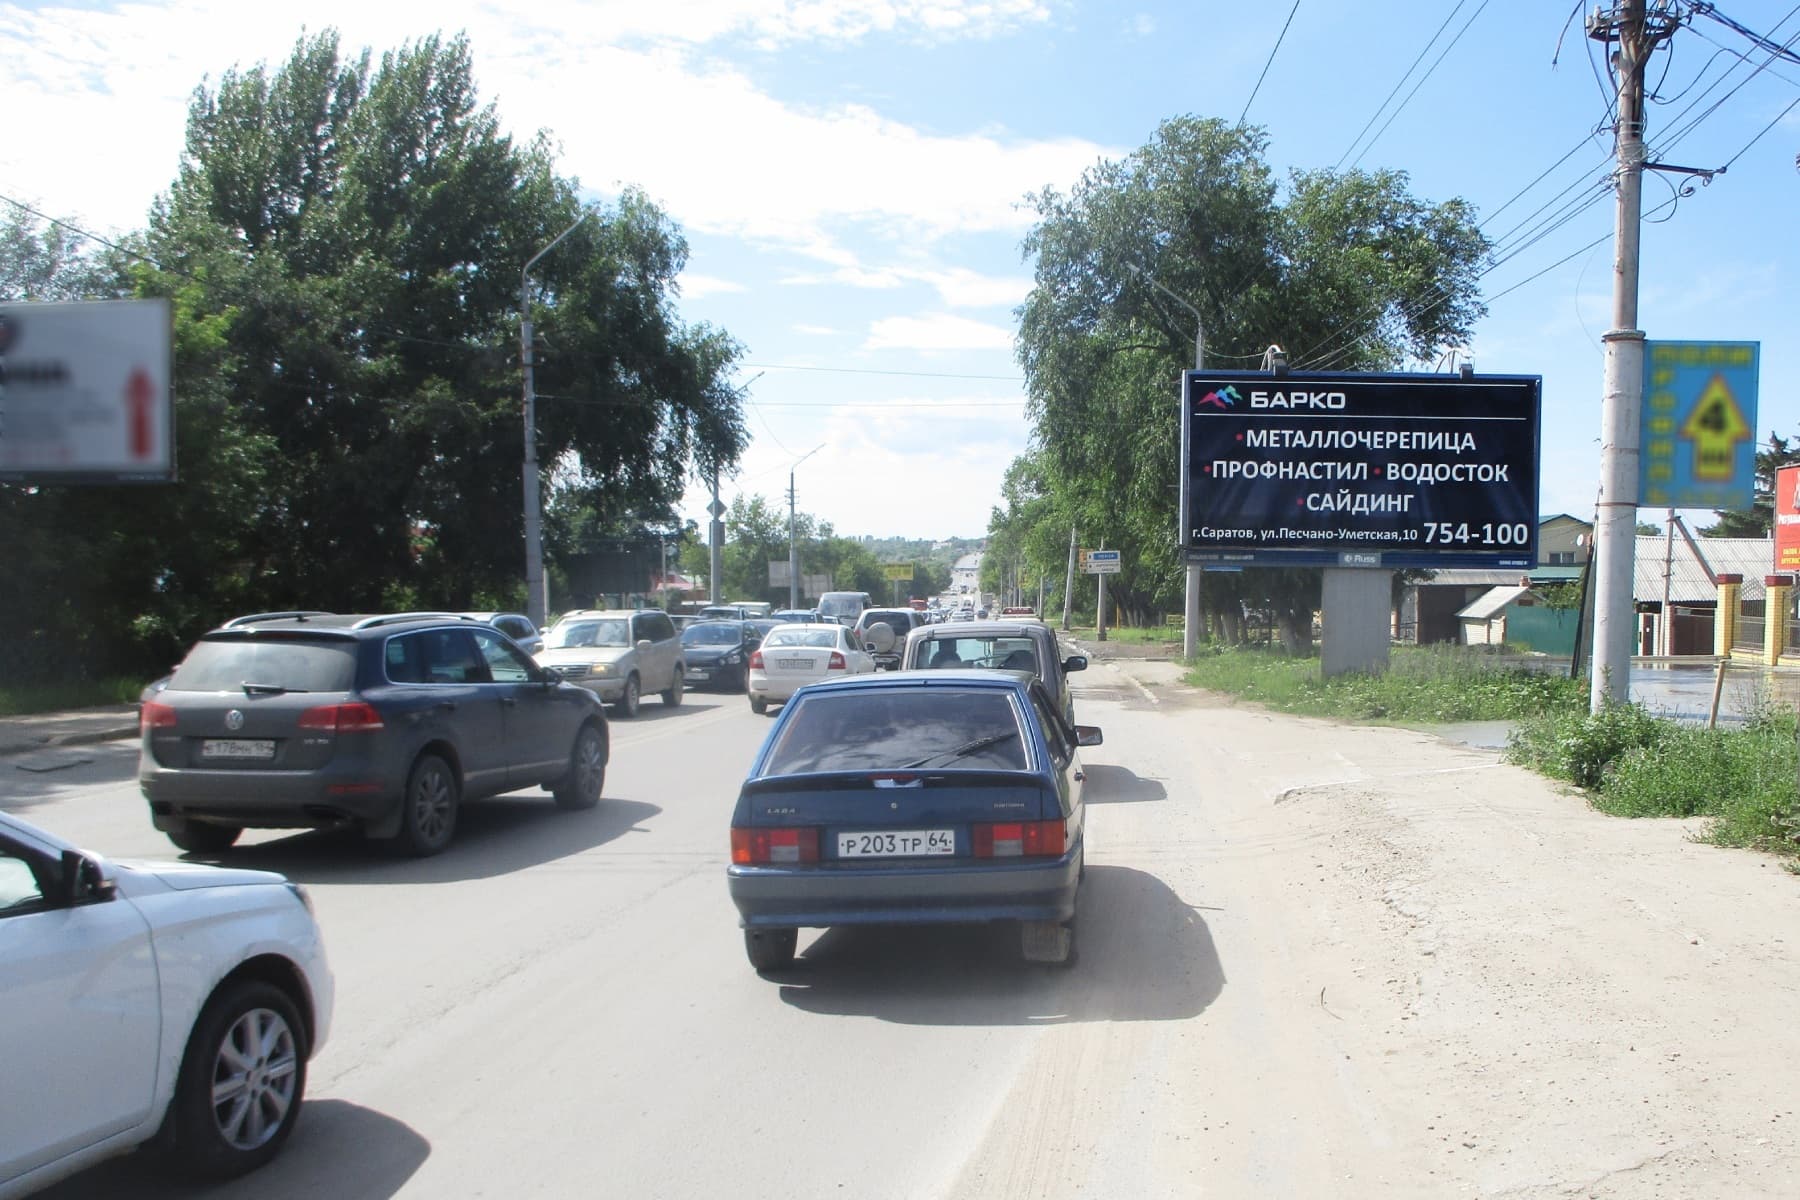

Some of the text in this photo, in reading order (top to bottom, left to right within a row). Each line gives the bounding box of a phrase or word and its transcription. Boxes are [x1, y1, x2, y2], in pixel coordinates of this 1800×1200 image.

[1250, 391, 1346, 409] БАРКО
[1246, 429, 1476, 453] МЕТАЛЛОЧЕРЕПИЦА
[1212, 460, 1509, 486] ПРОФНАСТИЛ ВОДОСТОК
[1306, 488, 1415, 515] САЙДИНГ
[1192, 526, 1257, 541] г.Саратов,
[1423, 522, 1528, 545] 754-100
